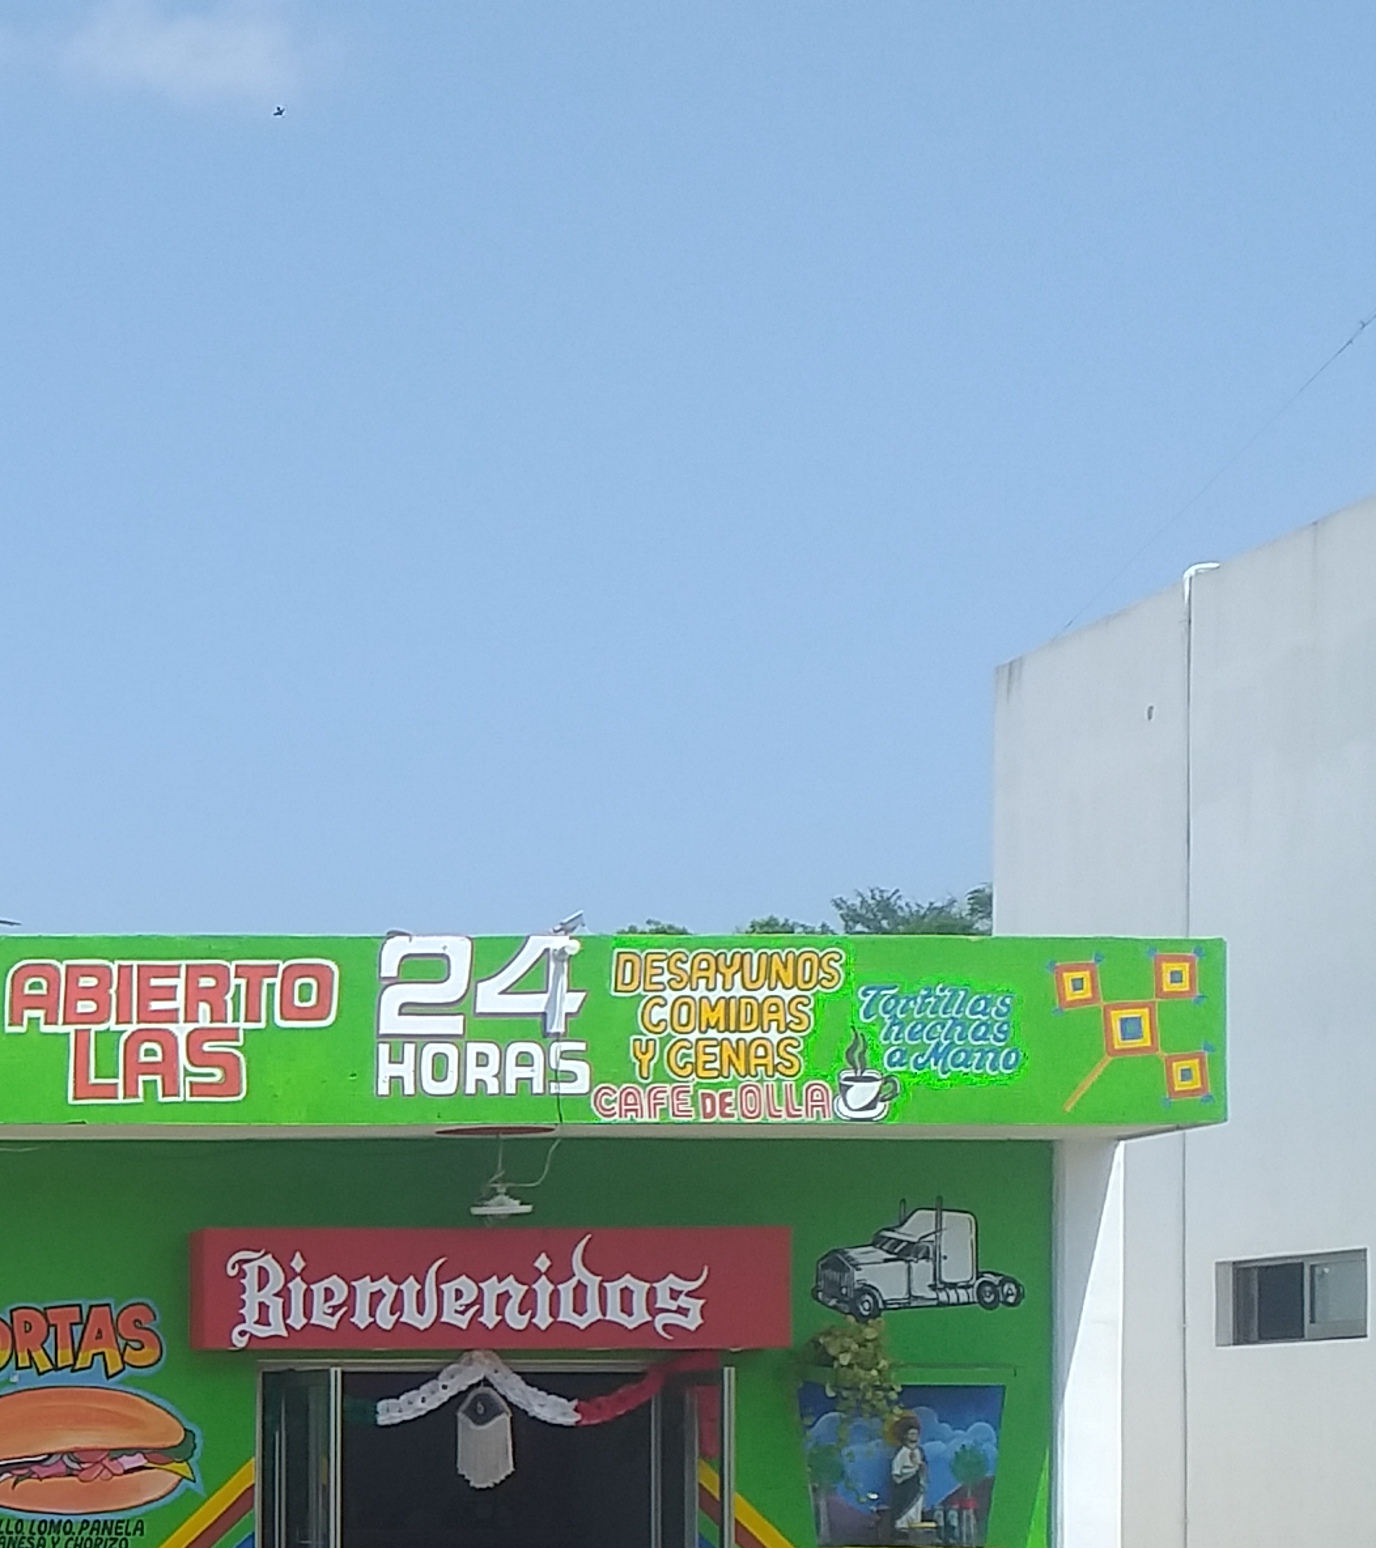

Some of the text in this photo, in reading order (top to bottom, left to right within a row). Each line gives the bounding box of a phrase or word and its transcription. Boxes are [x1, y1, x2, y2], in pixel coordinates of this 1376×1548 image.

[376, 931, 589, 1037] 24
[612, 949, 843, 995] DESAYUNOS
[4, 959, 339, 1032] ABIERTO
[639, 994, 813, 1034] COMIDAS
[858, 984, 1016, 1022] Tortillas
[880, 1015, 1010, 1045] hechas
[67, 1027, 245, 1103] LAS
[375, 1040, 592, 1097] HORAS
[631, 1036, 802, 1080] Y CENAS
[884, 1040, 1022, 1078] a Mano
[593, 1083, 833, 1119] CAFE DE OLLA
[225, 1233, 709, 1349] Bienvenidos
[78, 1518, 144, 1537] PANELA
